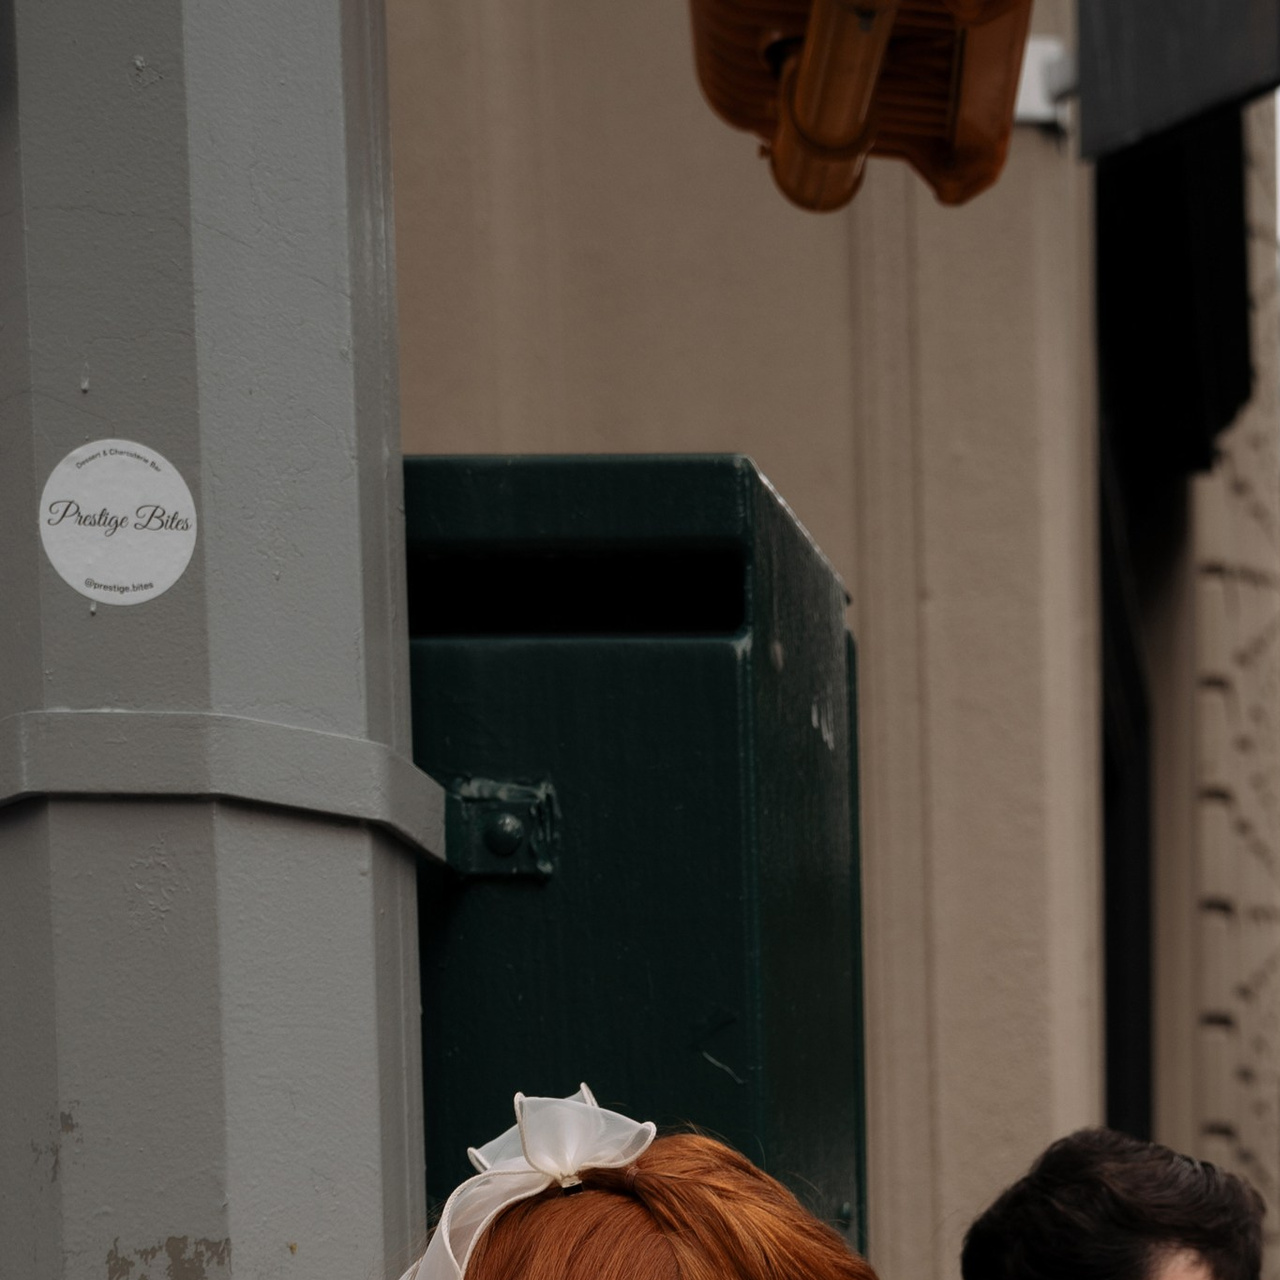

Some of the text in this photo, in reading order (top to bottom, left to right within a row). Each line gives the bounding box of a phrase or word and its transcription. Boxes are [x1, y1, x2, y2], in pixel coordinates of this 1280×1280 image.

[149, 460, 161, 472] Bar
[47, 500, 192, 537] Prestige Bites
[84, 577, 154, 594] @prestige.bites
